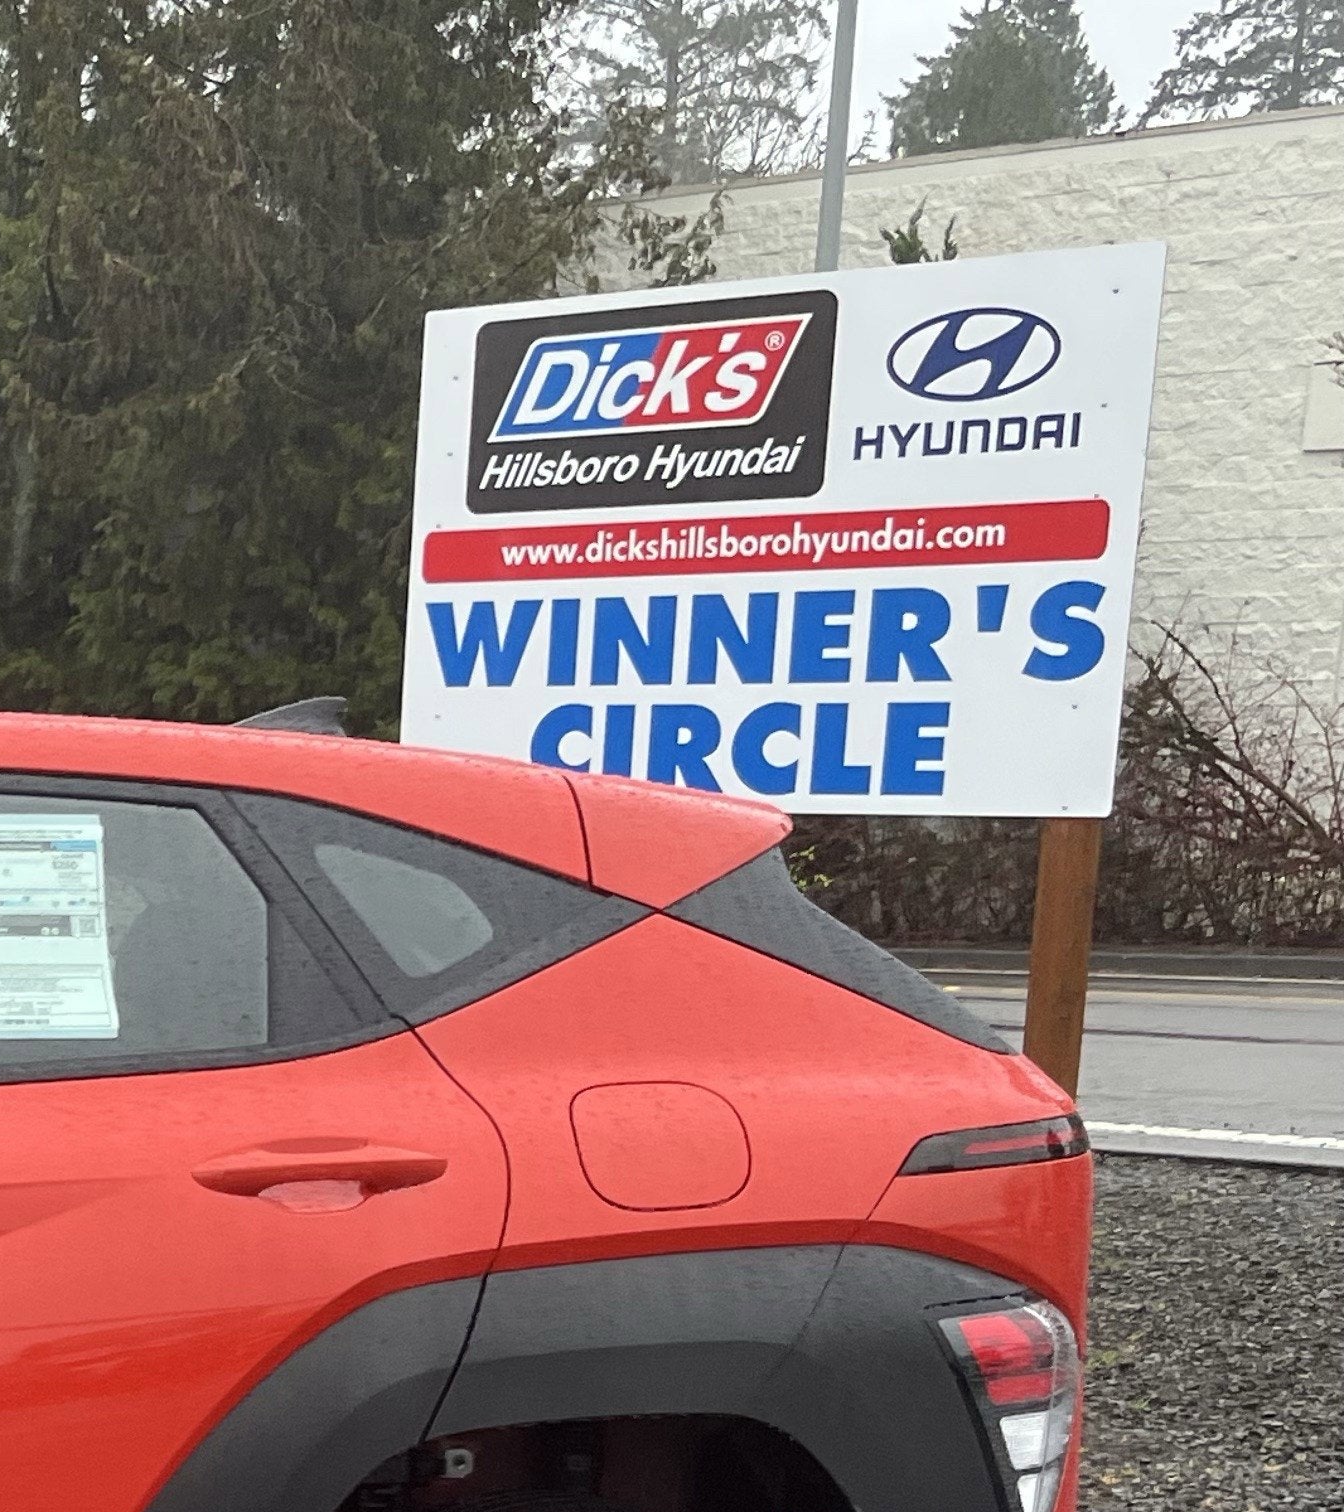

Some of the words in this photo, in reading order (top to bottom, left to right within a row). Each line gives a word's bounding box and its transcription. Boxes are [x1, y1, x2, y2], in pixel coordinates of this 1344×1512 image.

[479, 450, 640, 490] Hillsboro
[643, 435, 807, 490] Hyundai
[853, 412, 1082, 461] HYUNDAI
[501, 517, 1007, 566] www.dickshillsborohyundai.com
[425, 580, 1107, 688] WINNER'S
[530, 700, 952, 796] CIRCLE
